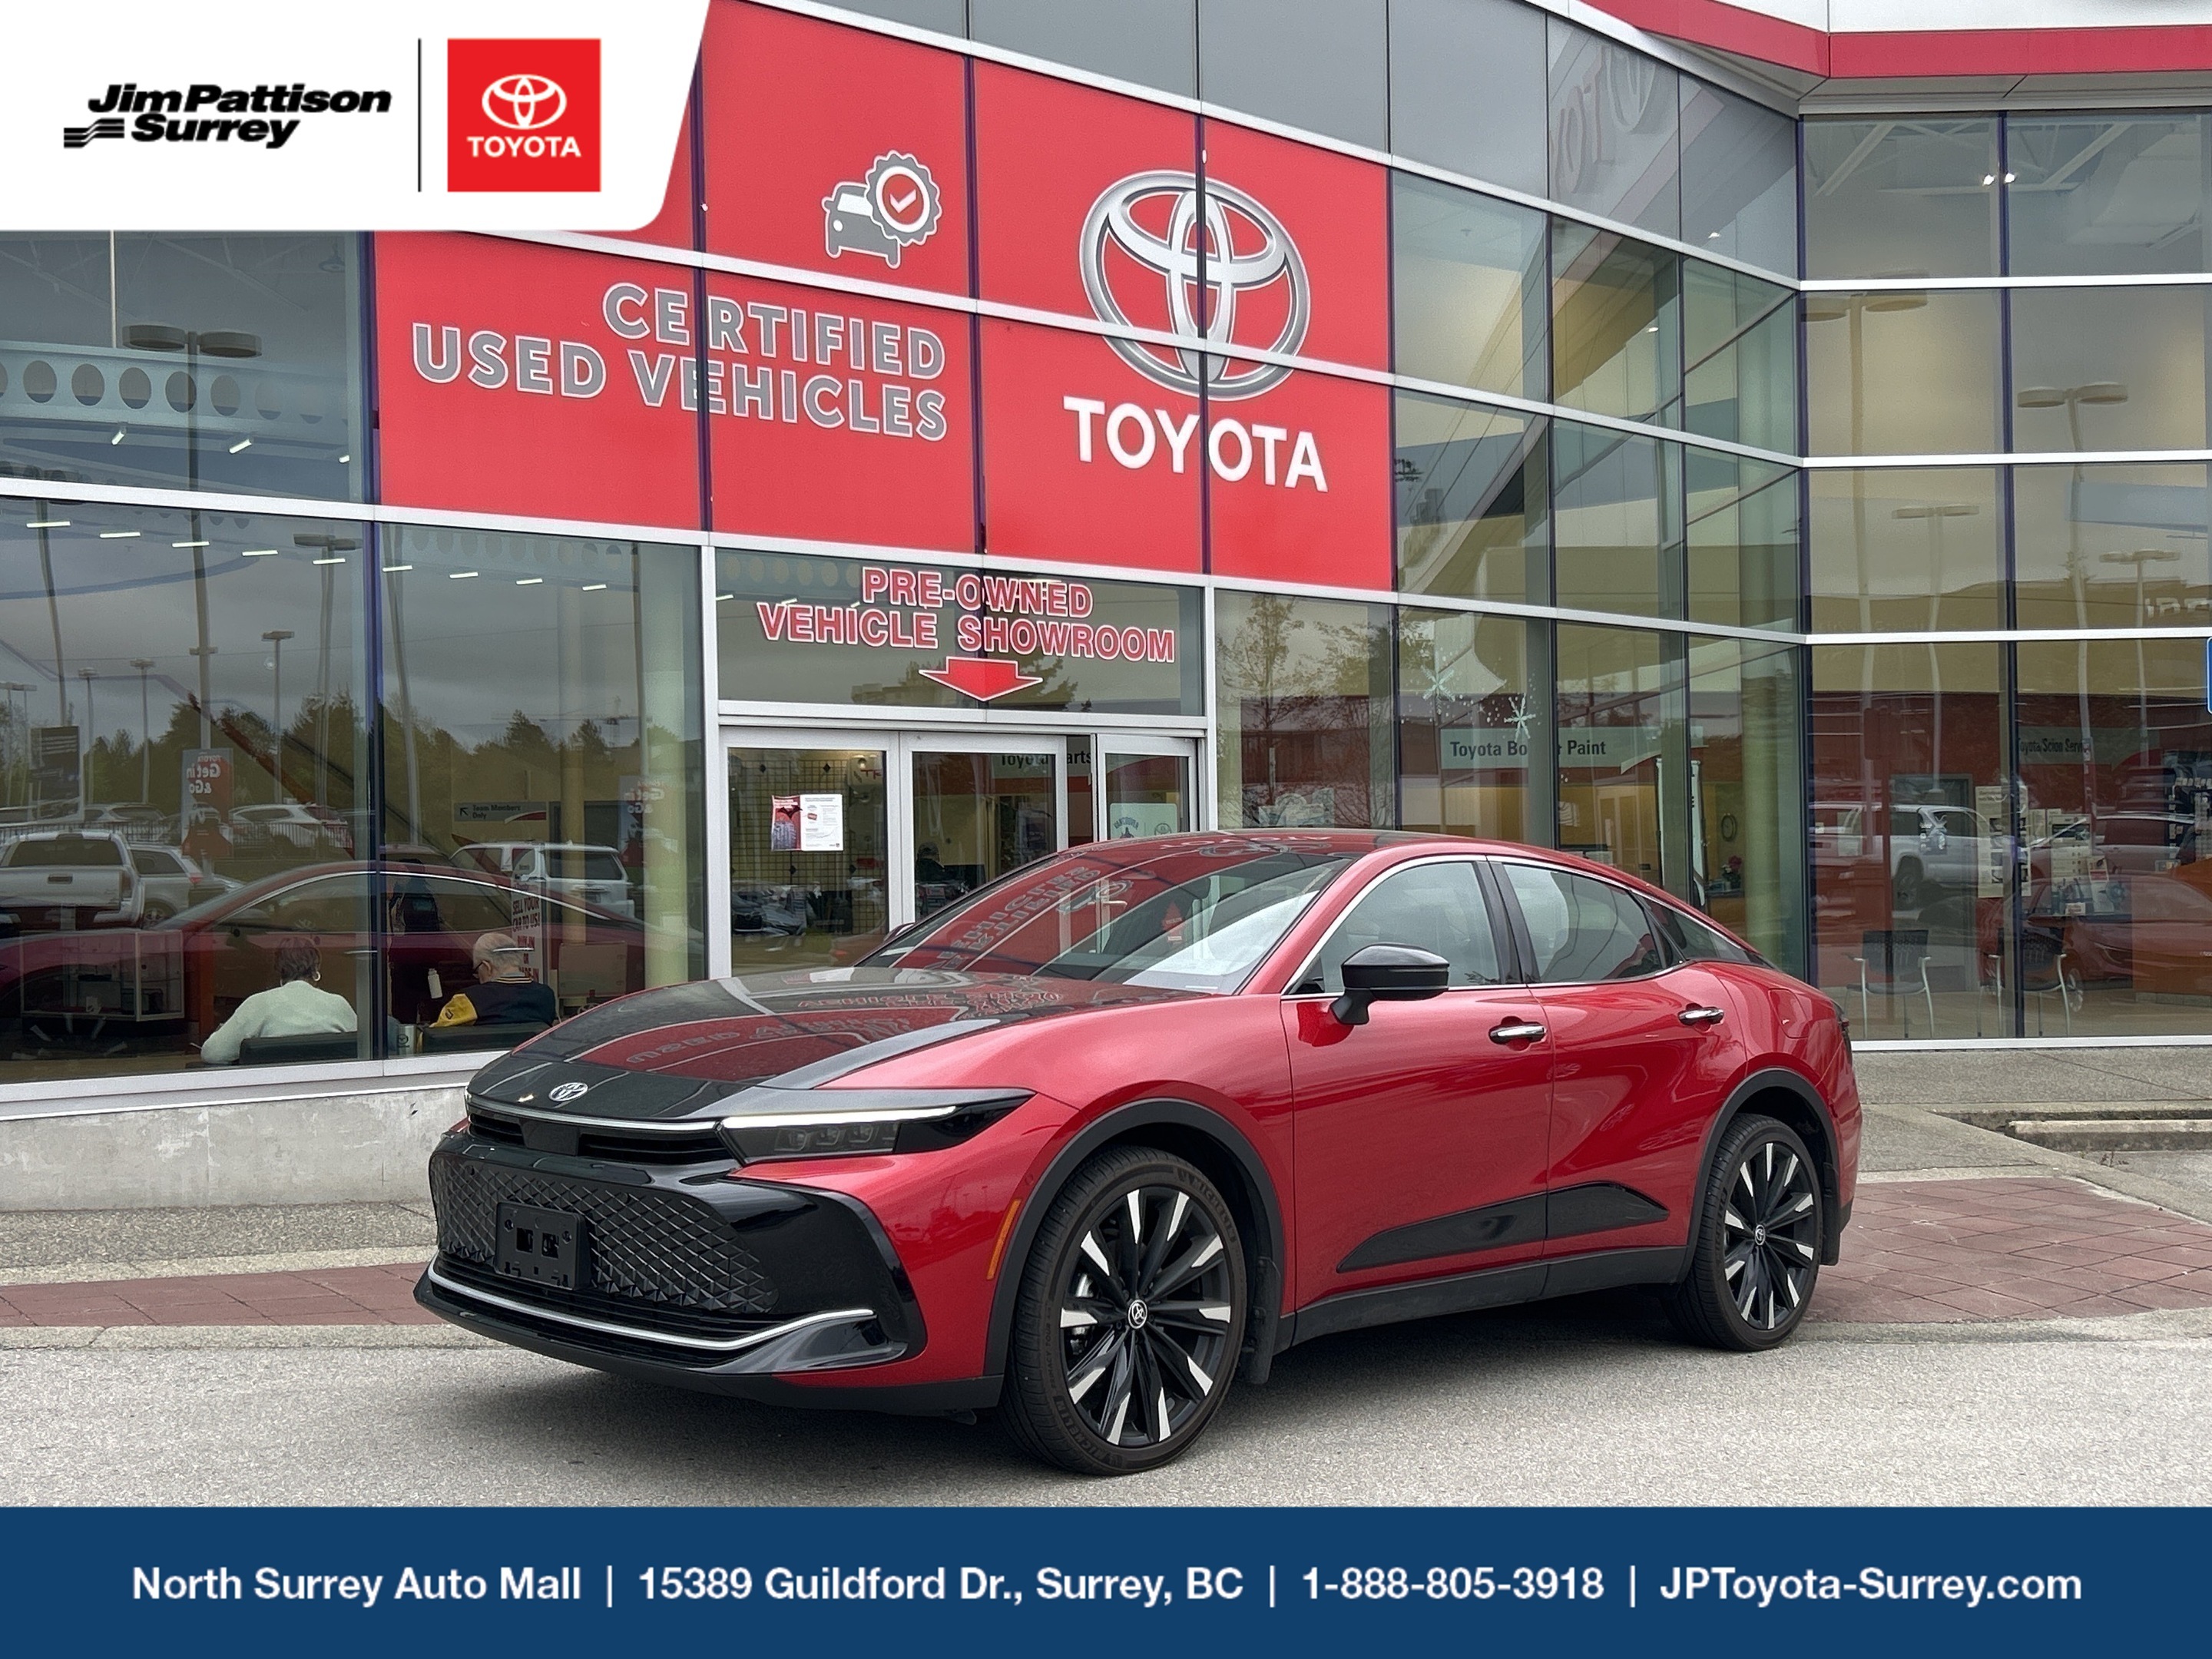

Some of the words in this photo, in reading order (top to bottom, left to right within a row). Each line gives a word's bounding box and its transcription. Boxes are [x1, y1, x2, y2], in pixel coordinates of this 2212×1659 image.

[603, 282, 945, 380] CERTIFIED
[412, 323, 607, 399] USED
[628, 349, 948, 442] VEHICLES
[1063, 396, 1329, 492] TOYOTA
[861, 566, 1094, 619] PRE-OWNED
[757, 601, 939, 648] VEHICLE
[957, 614, 1175, 663] SHOWROOM
[1066, 750, 1091, 764] arts
[1450, 741, 1502, 760] Toyota
[1508, 740, 1528, 756] Bo
[1568, 740, 1606, 755] Paint
[1055, 1398, 1108, 1459] MICHELIN
